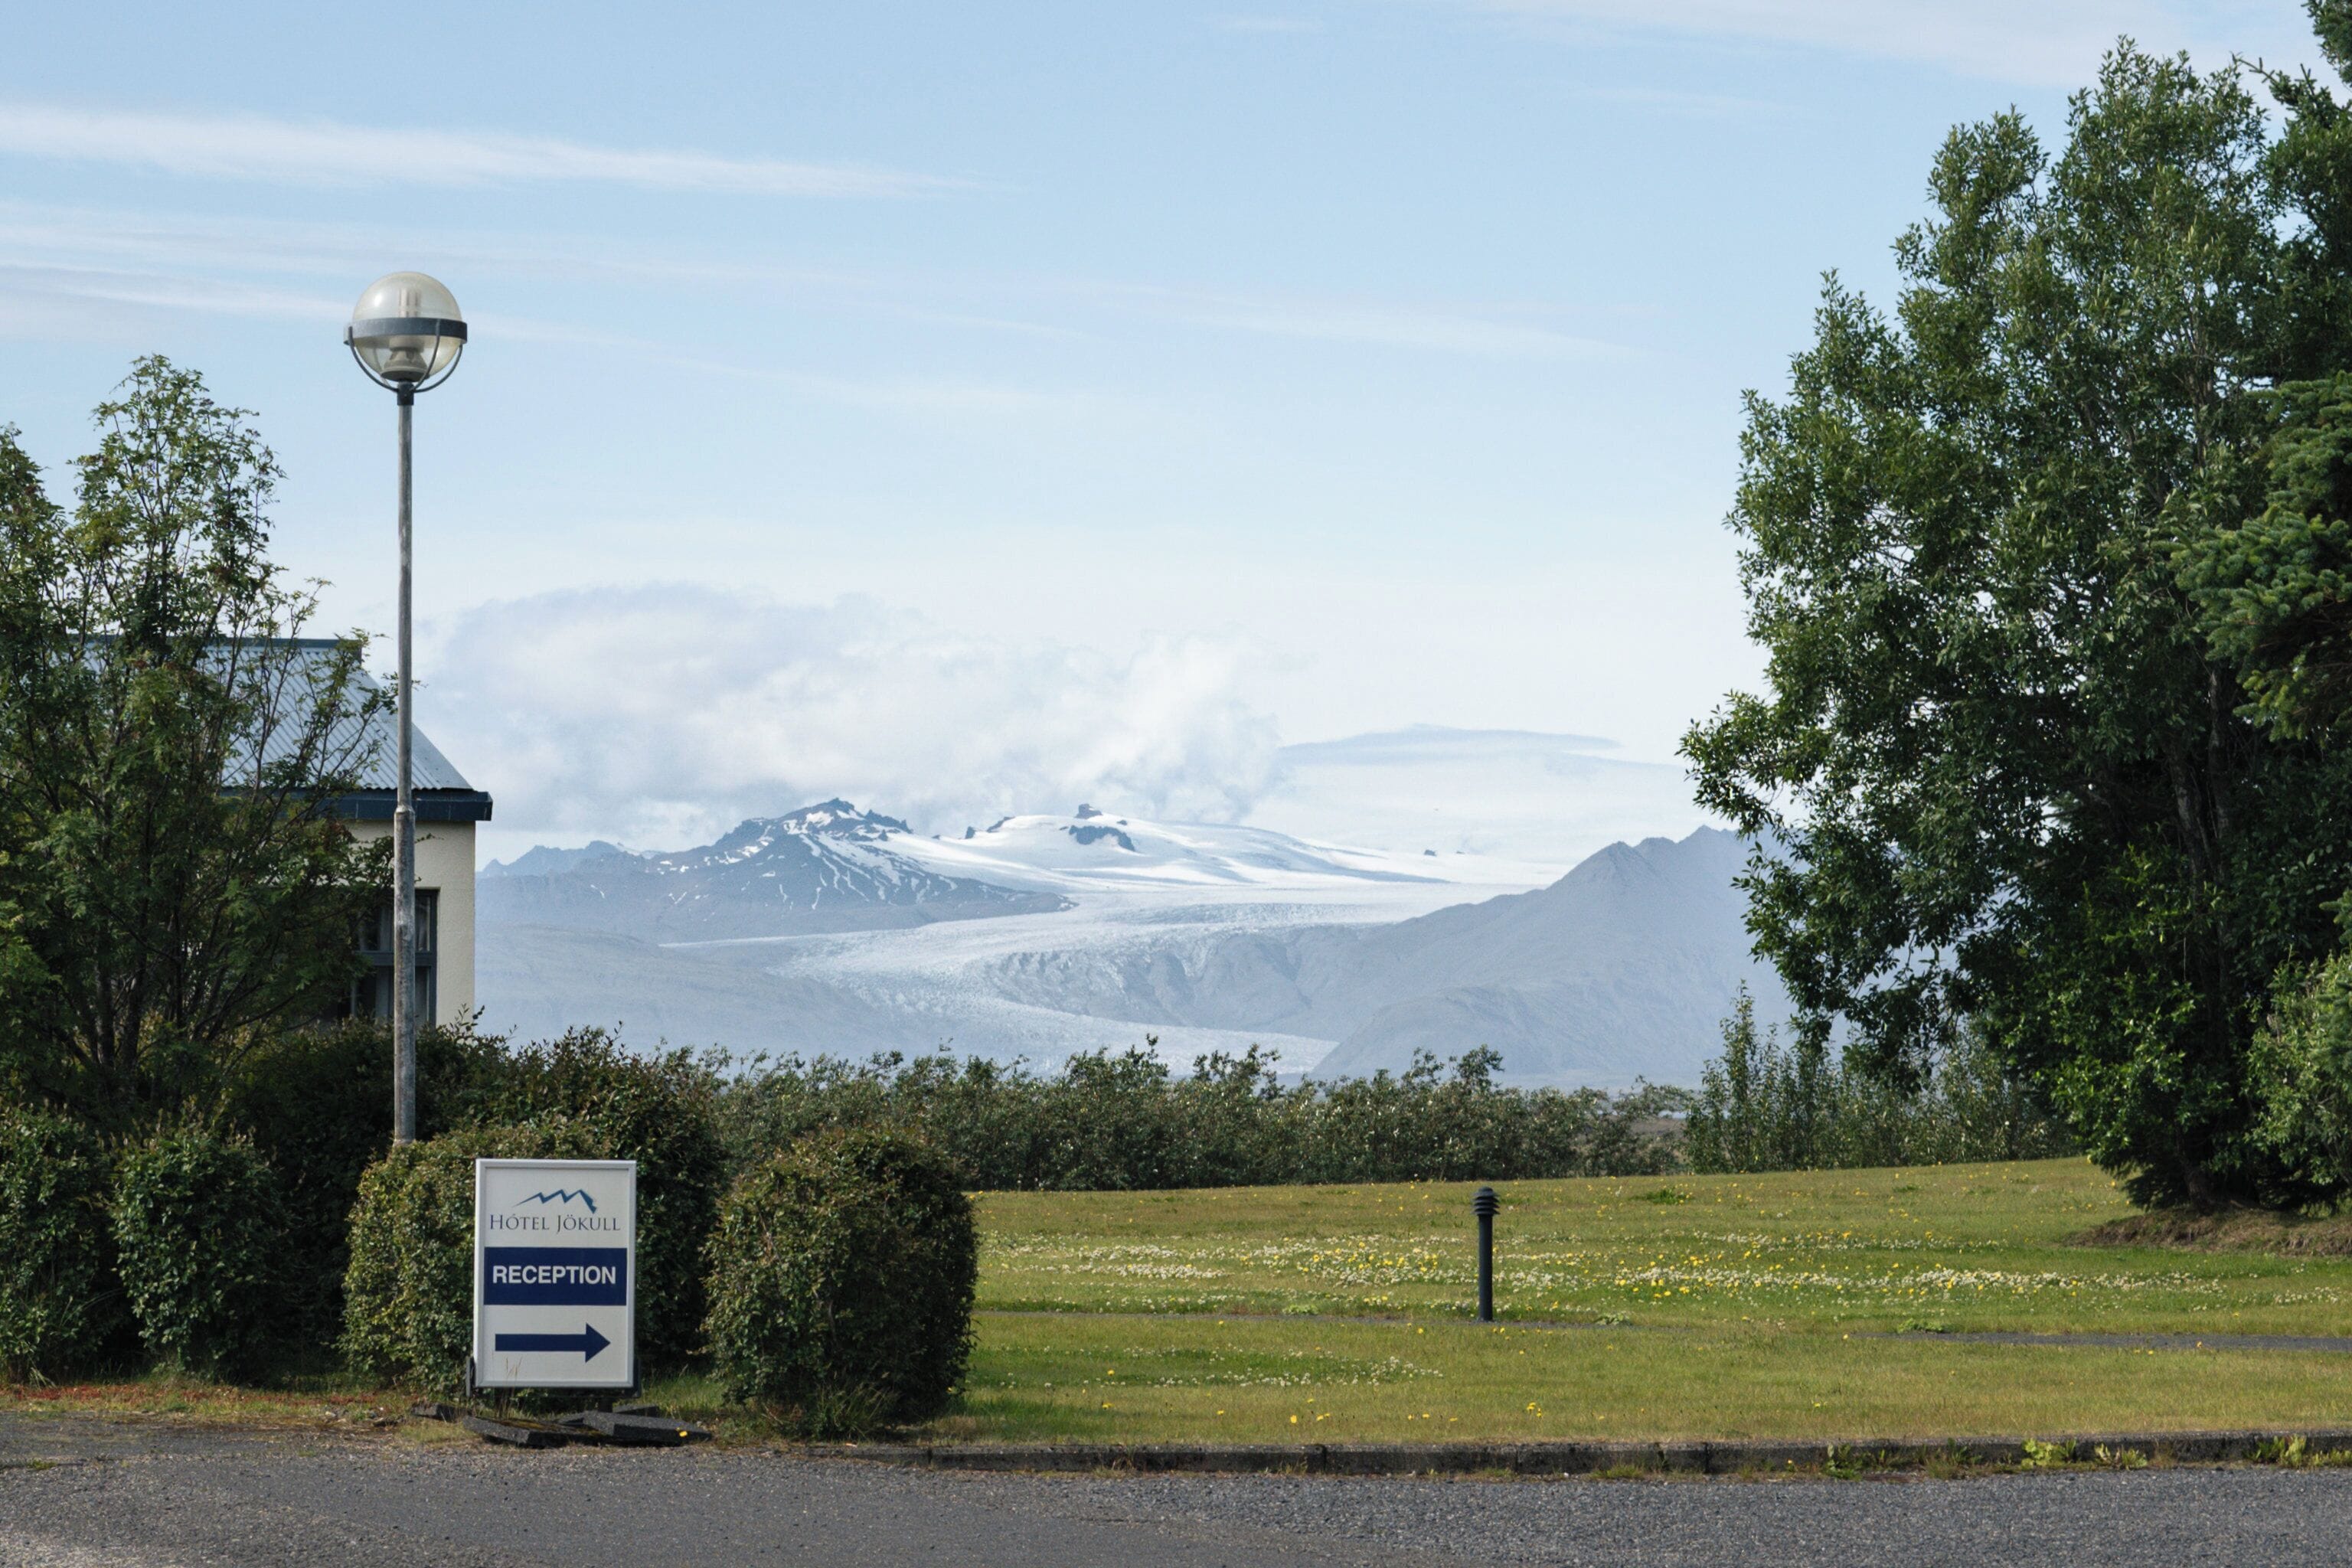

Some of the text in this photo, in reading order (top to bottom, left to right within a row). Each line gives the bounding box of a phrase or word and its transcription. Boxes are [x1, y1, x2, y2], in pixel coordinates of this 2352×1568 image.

[490, 1214, 621, 1233] HÓTEL JÖKULL
[492, 1265, 617, 1285] RECEPTION
